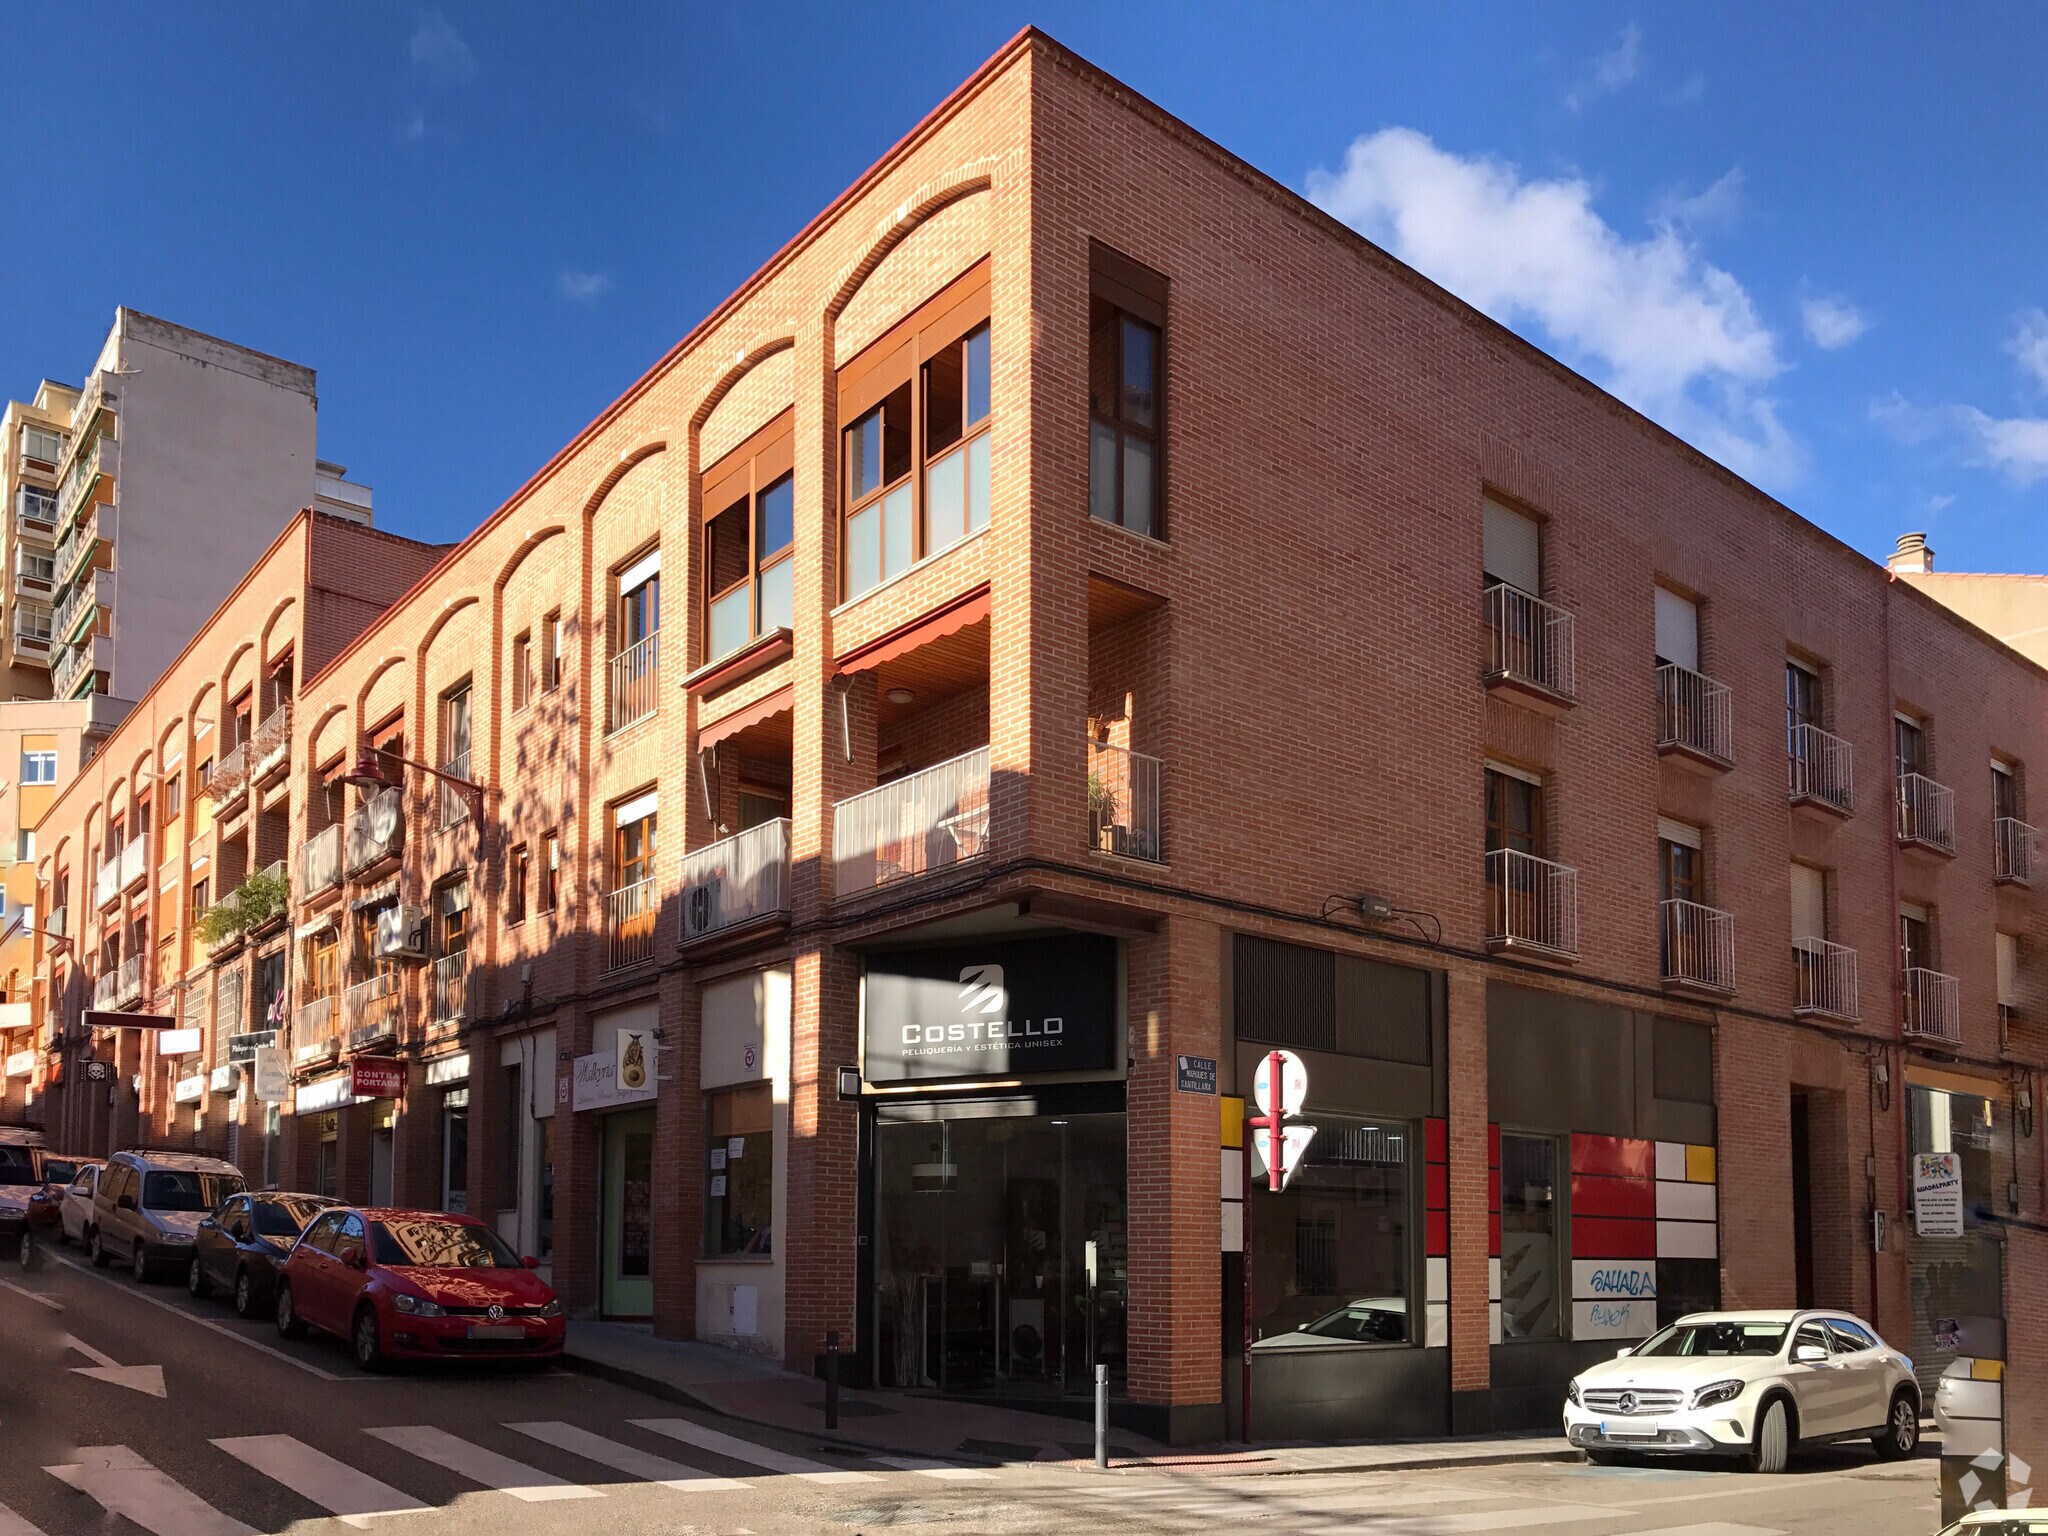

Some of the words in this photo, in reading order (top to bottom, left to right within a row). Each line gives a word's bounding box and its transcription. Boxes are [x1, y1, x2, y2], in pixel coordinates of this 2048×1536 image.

[901, 1017, 1063, 1044] COSTELLO
[902, 1043, 963, 1056] PELUQUERÍA
[974, 1041, 1021, 1051] ESTÉTICA
[1024, 1039, 1063, 1049] UNISEX
[1193, 1059, 1212, 1071] CALLE
[356, 1070, 400, 1080] CONTRA
[1209, 1072, 1216, 1082] DE
[356, 1078, 400, 1088] PORTADA
[1180, 1079, 1211, 1091] SANTILLANA
[1916, 1179, 1959, 1193] GUADALPARTY
